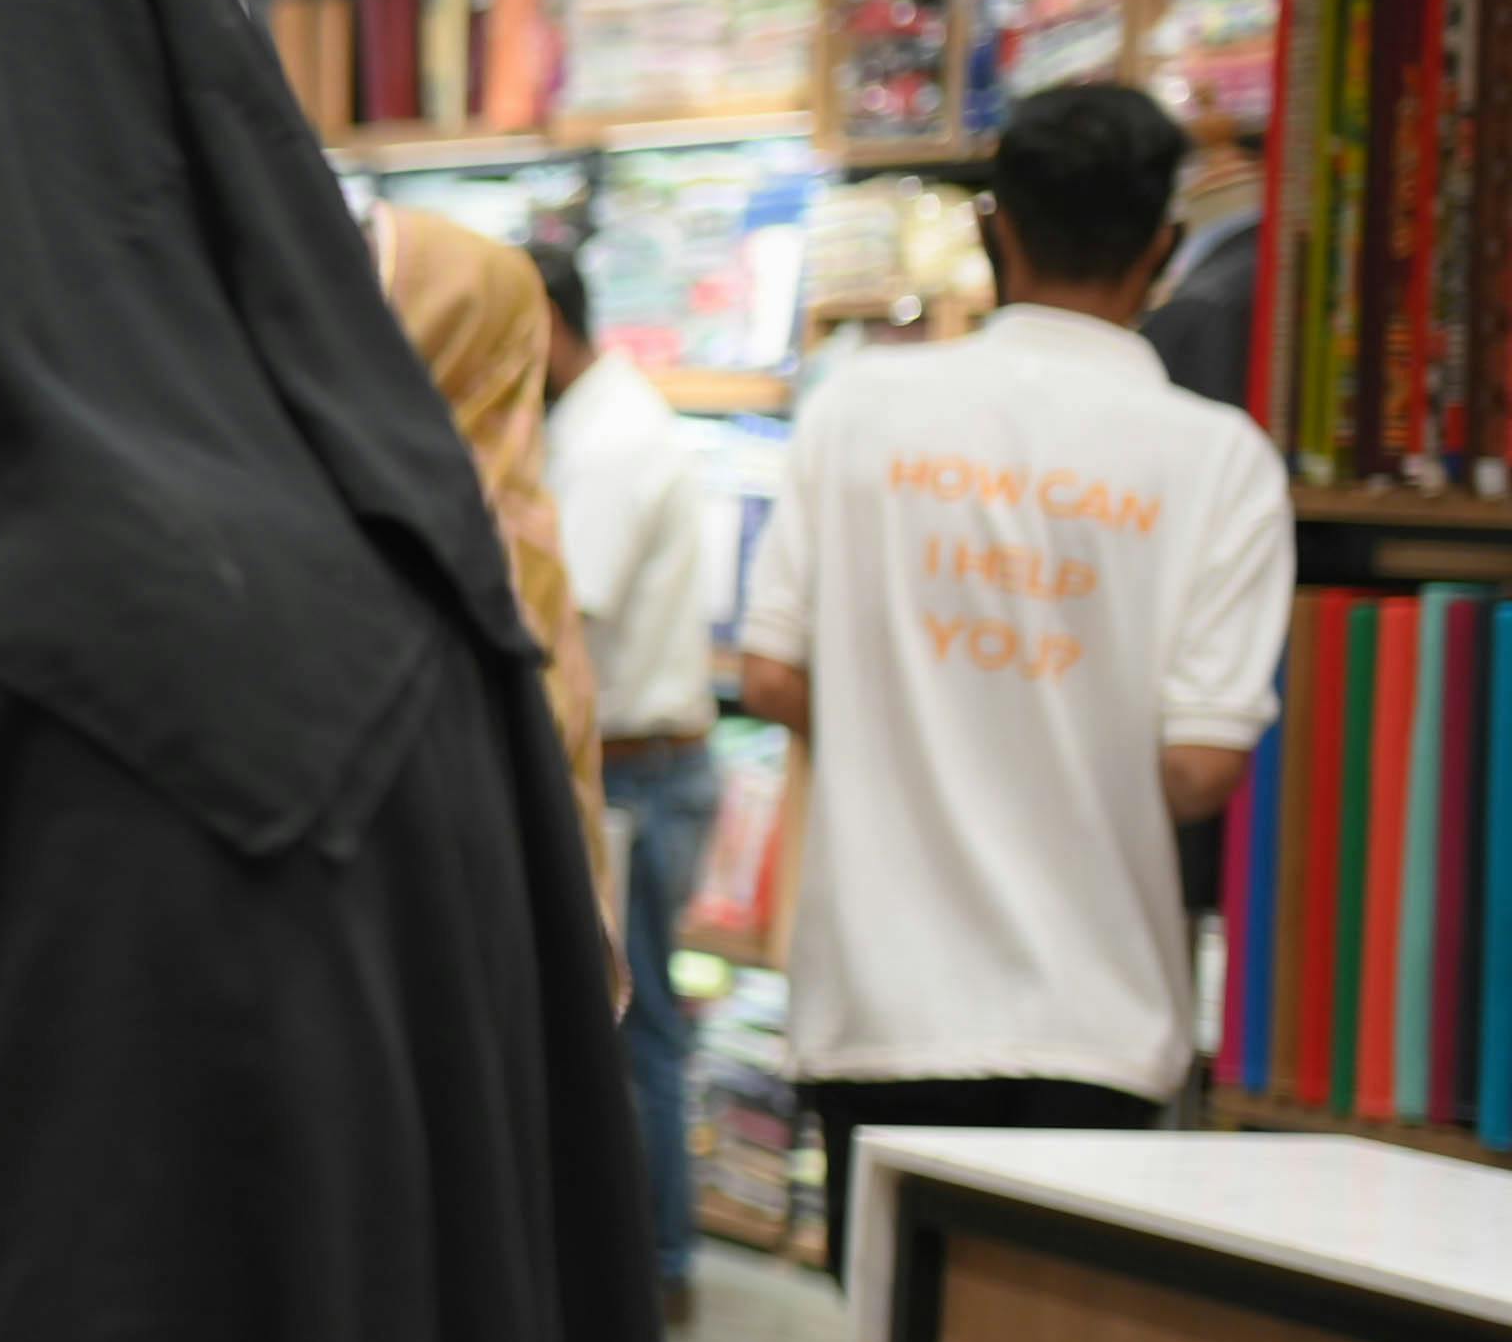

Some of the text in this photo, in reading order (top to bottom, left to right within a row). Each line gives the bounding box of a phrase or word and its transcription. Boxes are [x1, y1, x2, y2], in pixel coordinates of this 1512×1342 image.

[889, 454, 1161, 535] HOW CAN
[925, 535, 1098, 600] I HELP
